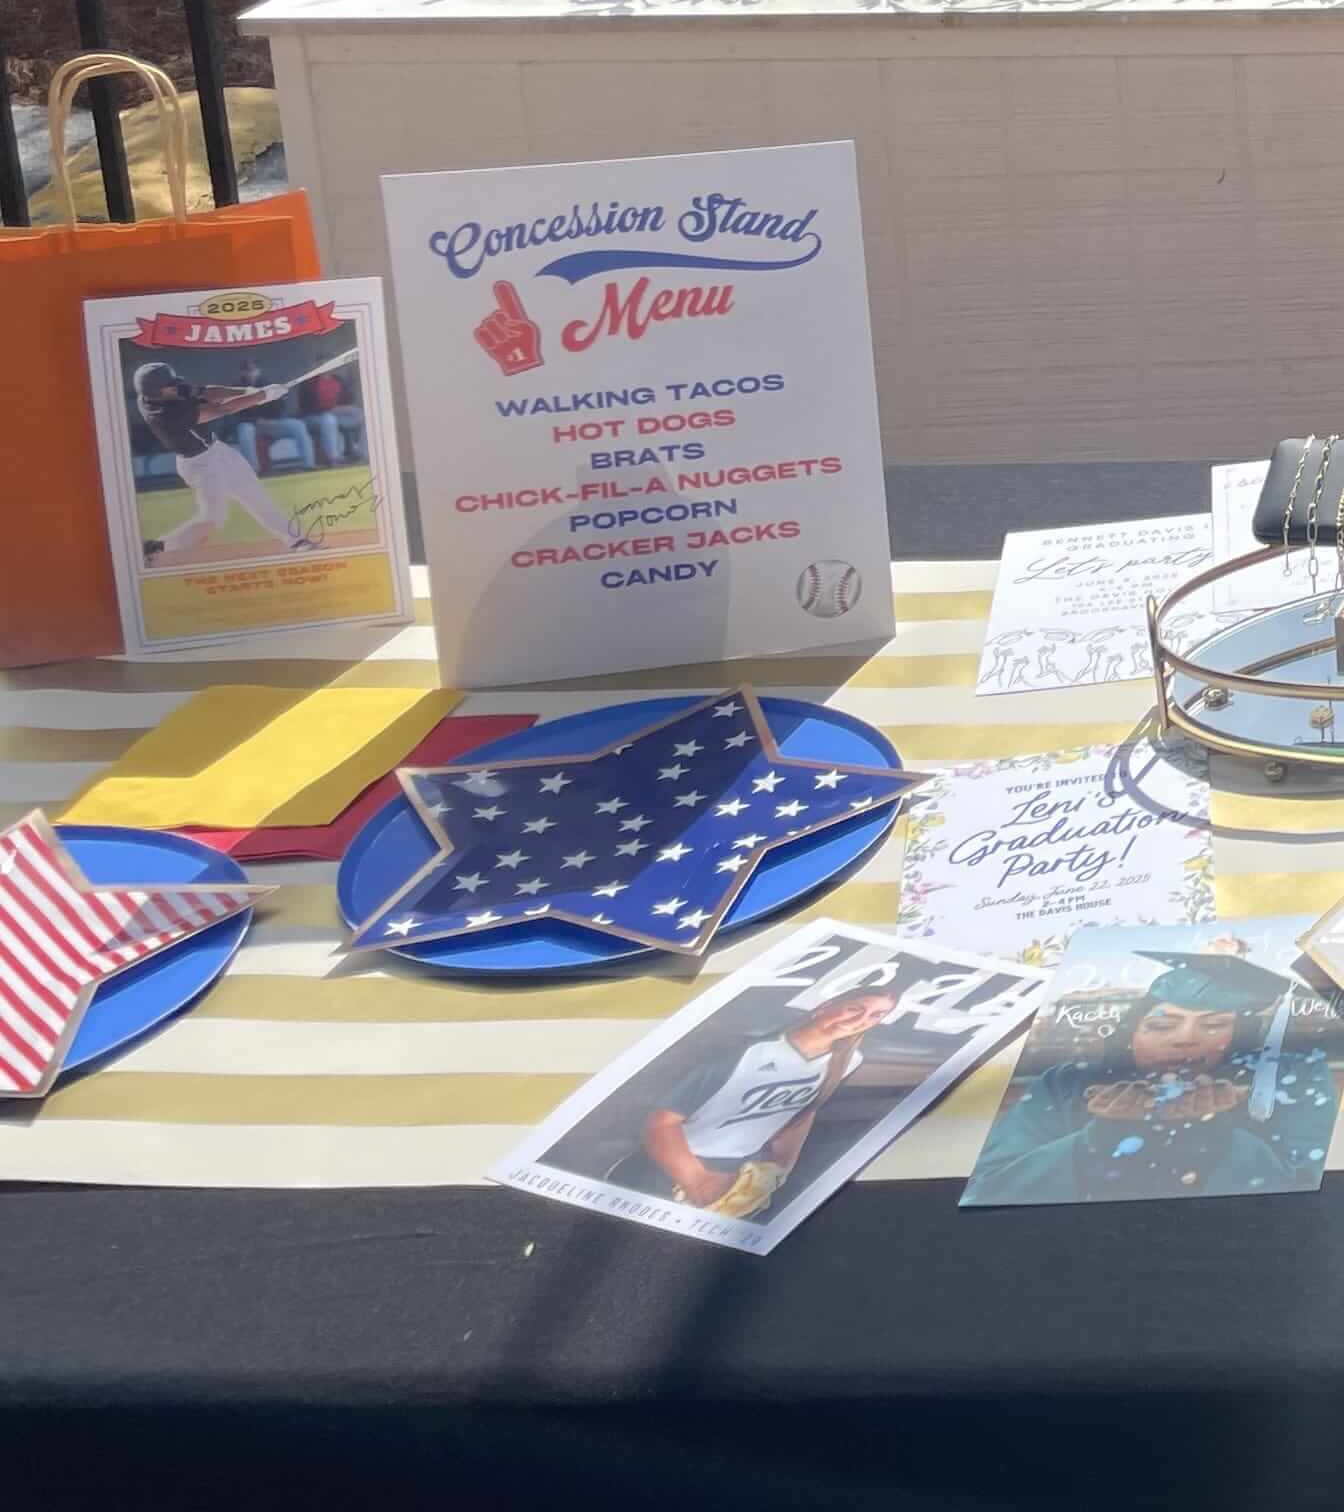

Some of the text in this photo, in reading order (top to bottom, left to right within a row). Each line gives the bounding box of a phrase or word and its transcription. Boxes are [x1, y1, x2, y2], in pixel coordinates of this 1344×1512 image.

[428, 193, 822, 278] Concession Stand
[206, 298, 265, 315] 2025
[561, 276, 735, 352] Menu
[184, 316, 291, 343] JAMES
[496, 374, 785, 417] WALKING TACOS
[552, 409, 737, 443] HOT DOGS
[590, 443, 706, 469] BRATS
[455, 457, 843, 513] CHICK-FIL-A NUGGETS
[569, 498, 738, 532] POPCORN
[511, 521, 801, 569] CRACKER JACKS
[600, 560, 720, 589] CANDY
[1005, 781, 1051, 795] YOU'RE
[1001, 789, 1119, 829] Leni's
[948, 808, 1192, 866] Graduation
[997, 834, 1137, 889] Party!
[1015, 898, 1112, 920] THE DAVIS HOUSE
